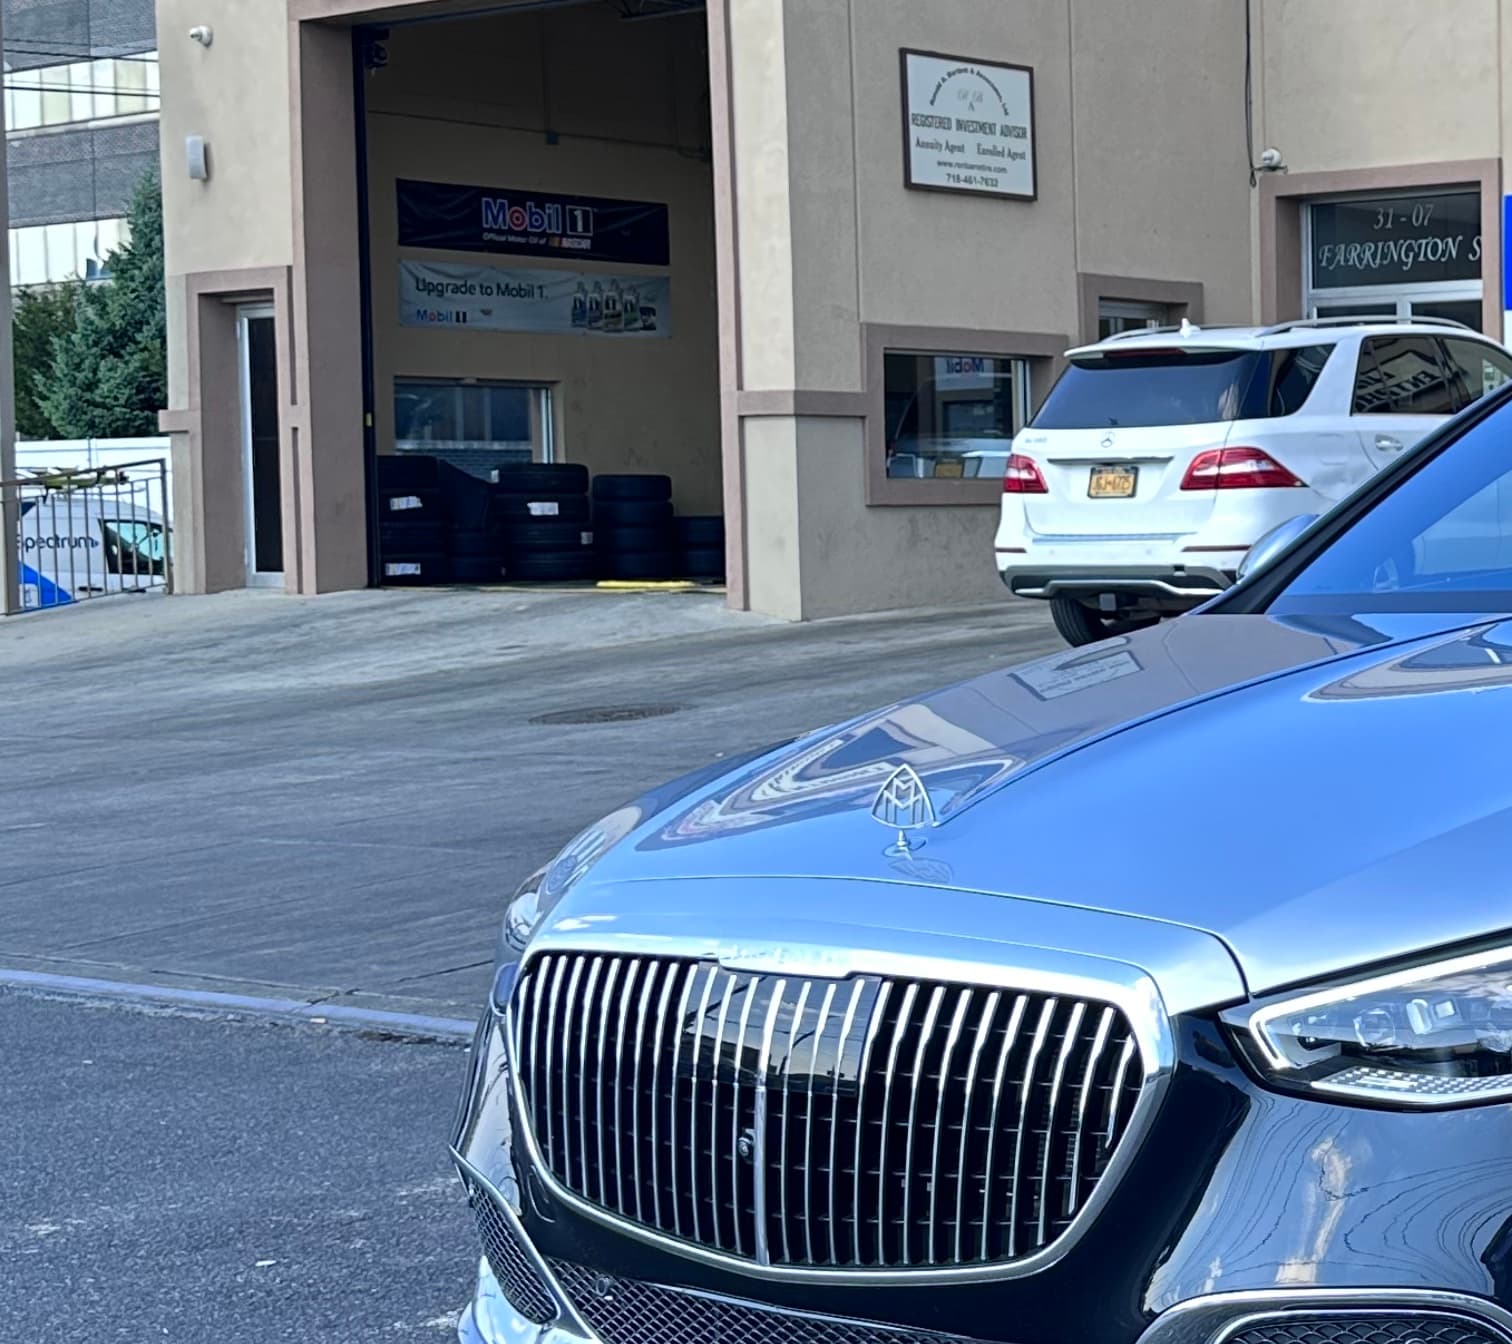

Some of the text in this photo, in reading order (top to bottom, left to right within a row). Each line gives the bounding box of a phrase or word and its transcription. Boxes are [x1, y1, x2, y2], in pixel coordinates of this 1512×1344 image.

[911, 113, 952, 131] REGISTERED
[955, 118, 997, 136] INVESTMENT
[481, 197, 562, 234] Mobil
[1318, 234, 1482, 271] FARRINGTON S
[416, 278, 477, 298] Upgrade
[480, 283, 493, 296] to
[496, 283, 535, 299] Mobil
[416, 308, 453, 323] Mobil
[17, 534, 94, 553] pectrum
